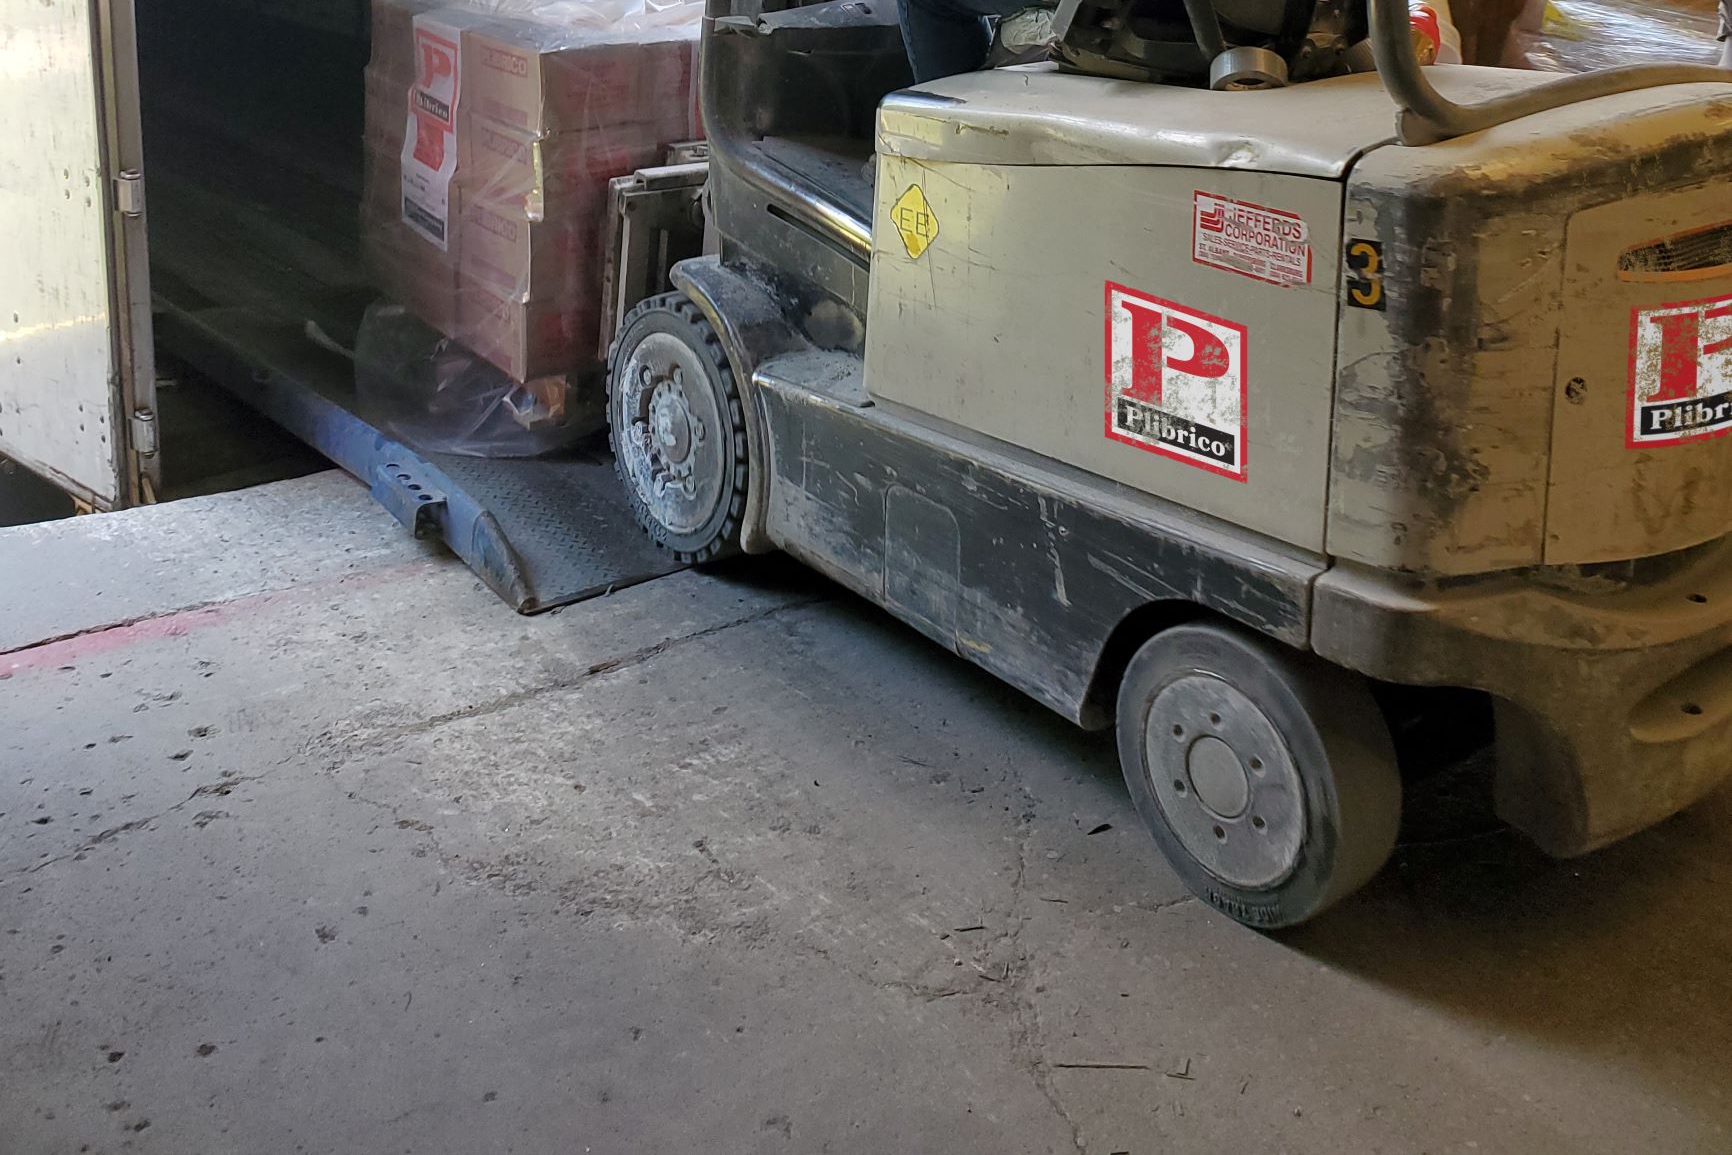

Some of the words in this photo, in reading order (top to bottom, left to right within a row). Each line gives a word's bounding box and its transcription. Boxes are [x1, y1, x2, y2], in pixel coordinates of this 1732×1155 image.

[1225, 223, 1305, 257] CORPORATION
[1121, 300, 1230, 406] P
[1126, 405, 1226, 457] Plibrico
